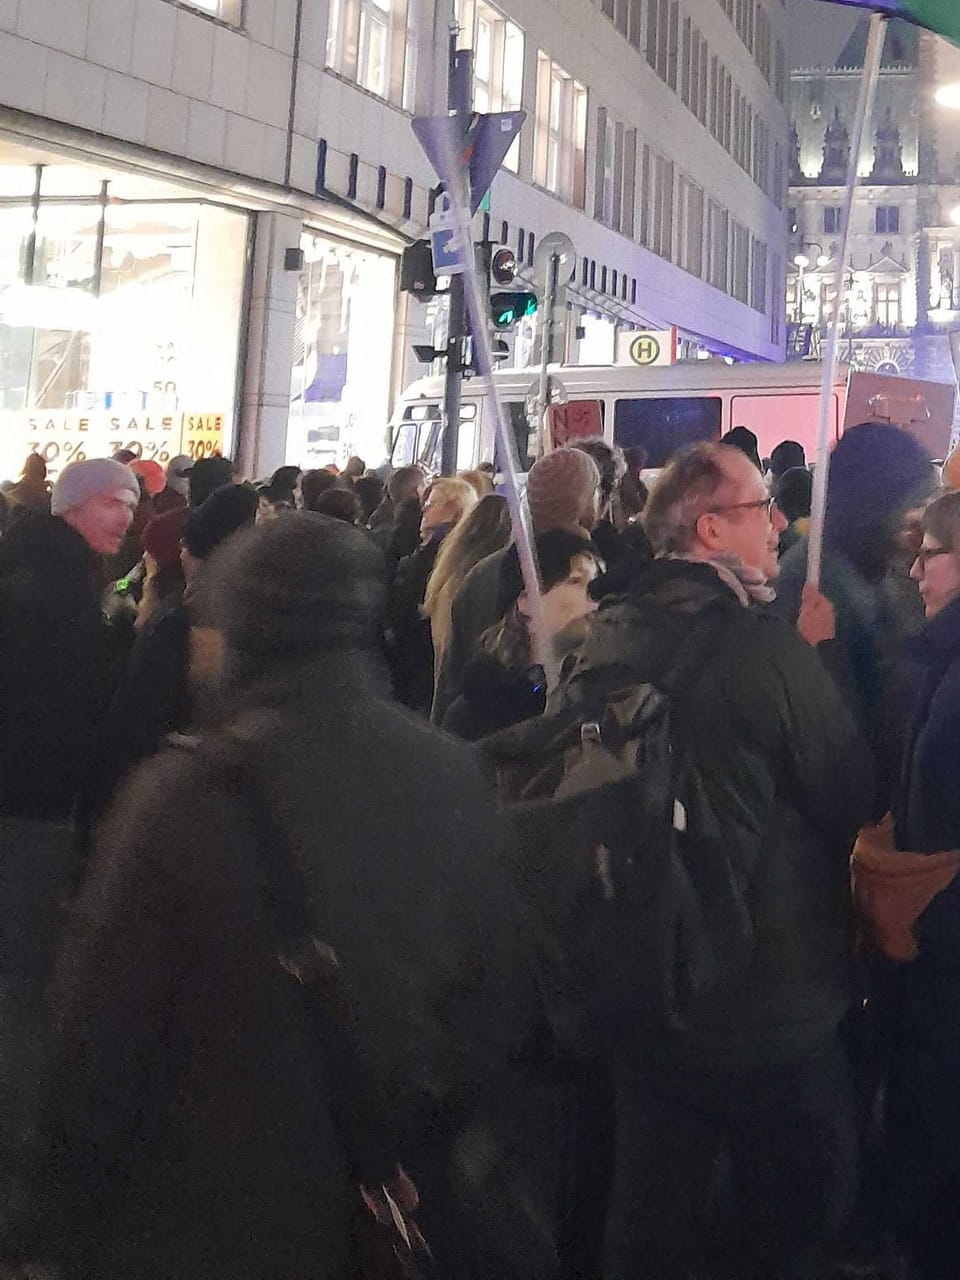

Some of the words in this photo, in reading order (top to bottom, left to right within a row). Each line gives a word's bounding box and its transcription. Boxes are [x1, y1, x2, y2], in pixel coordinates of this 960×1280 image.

[637, 341, 652, 359] H
[28, 418, 89, 431] SALE
[110, 417, 173, 431] SALE
[188, 416, 222, 431] SALE
